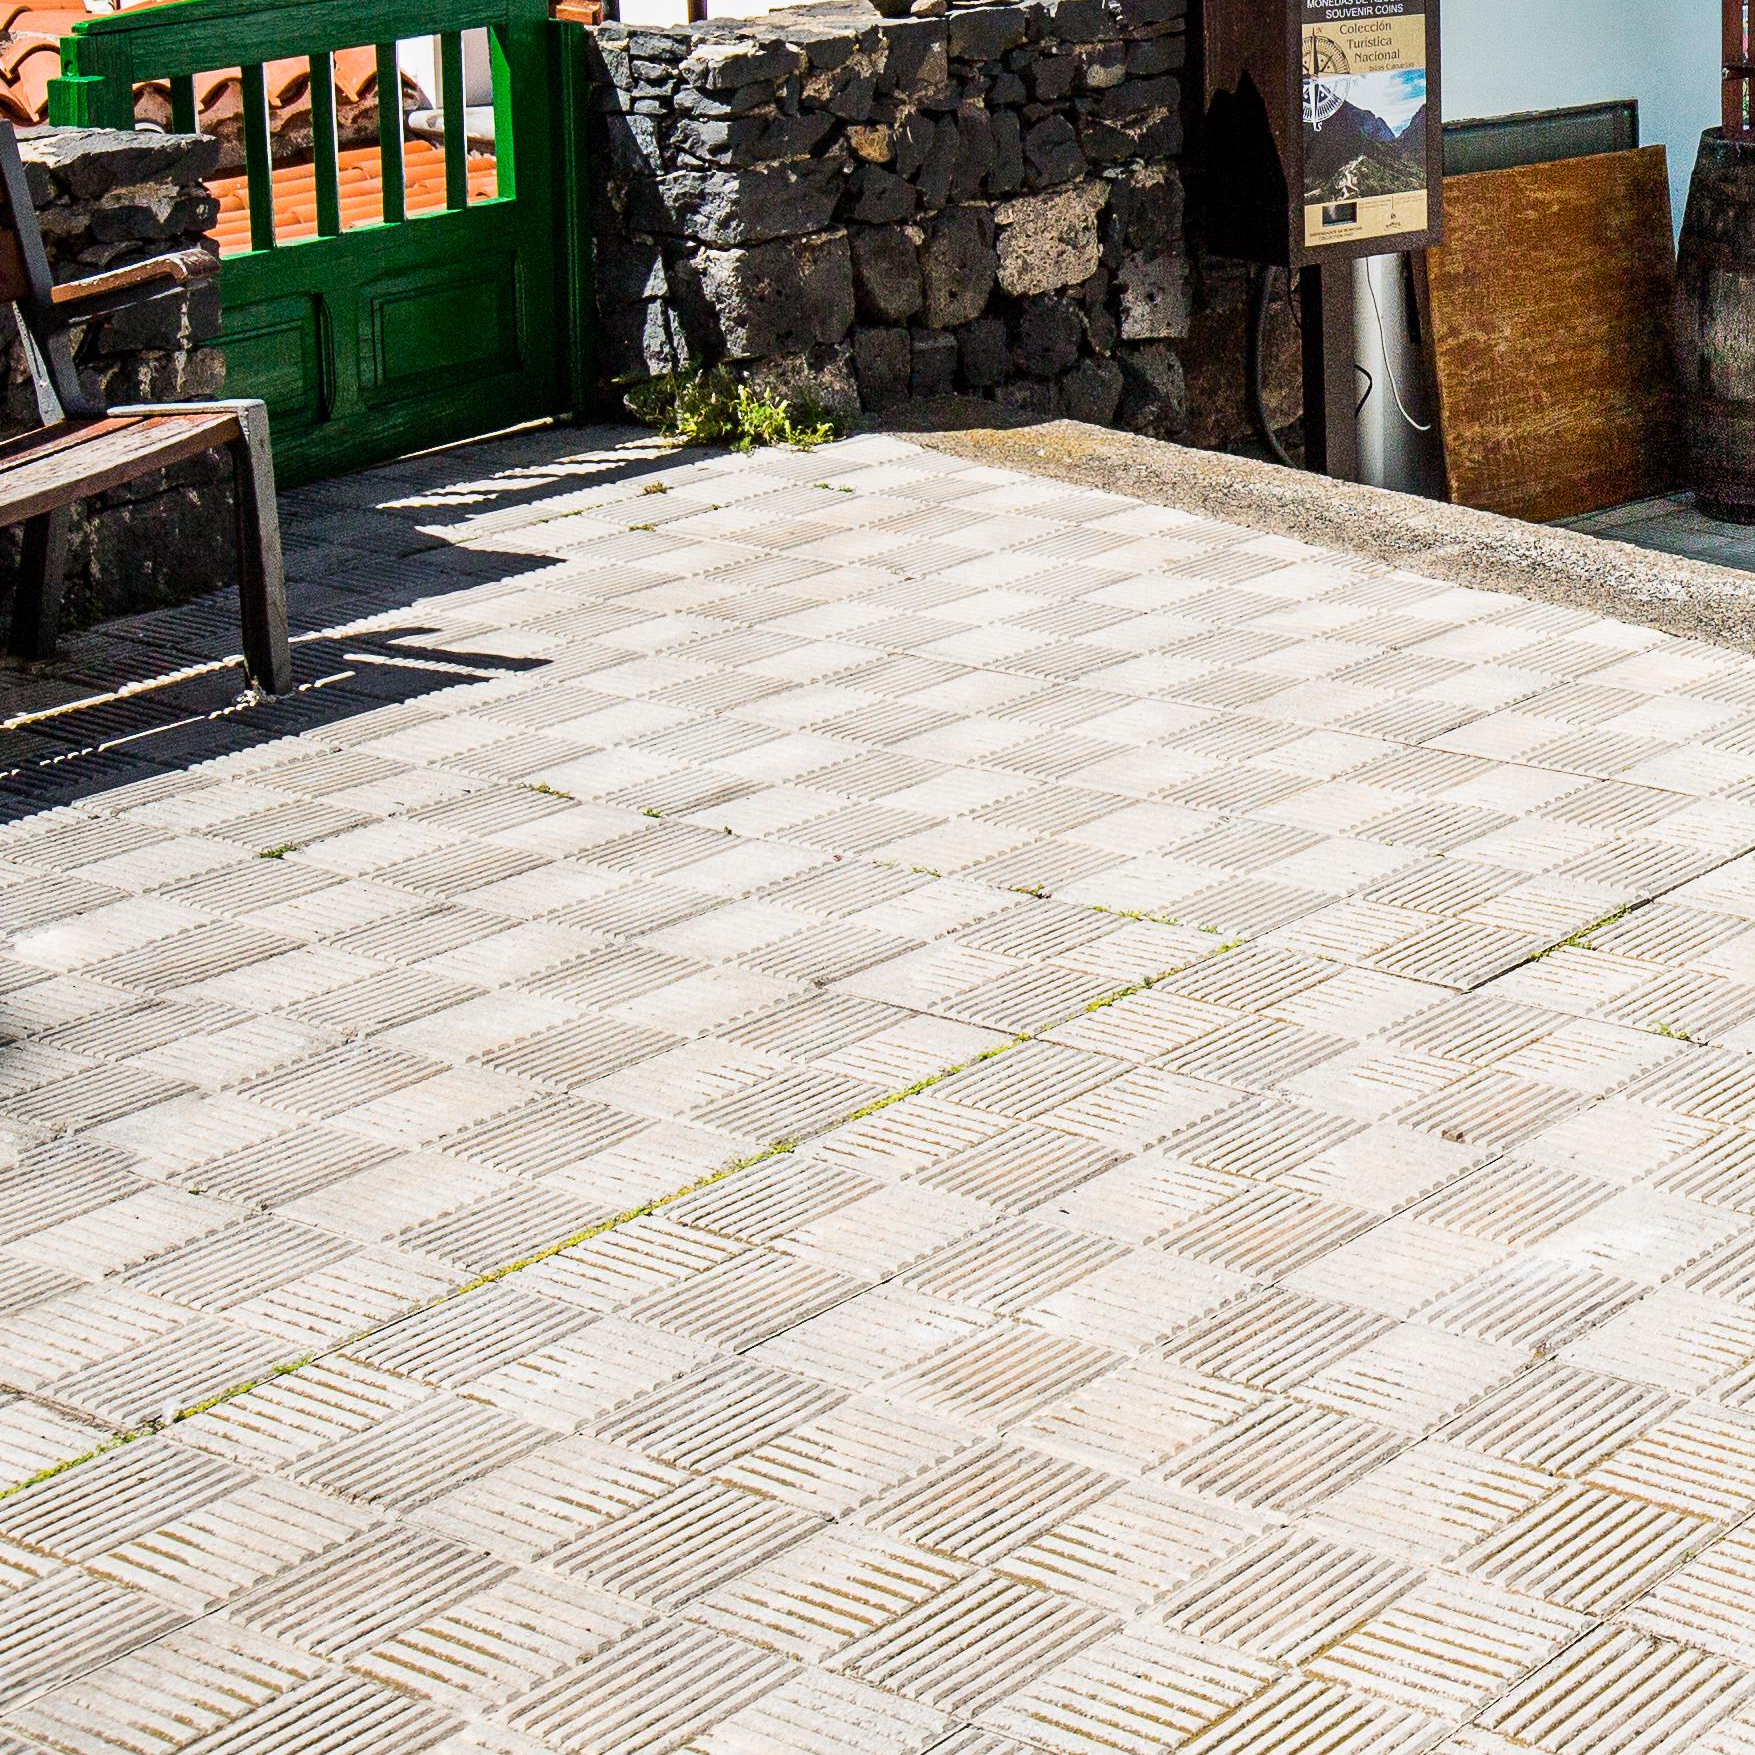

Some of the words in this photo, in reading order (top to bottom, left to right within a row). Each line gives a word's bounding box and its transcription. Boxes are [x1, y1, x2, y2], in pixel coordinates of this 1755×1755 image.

[1325, 6, 1374, 19] SOUVENIR
[1374, 3, 1404, 15] COINS
[1339, 20, 1392, 36] Colección
